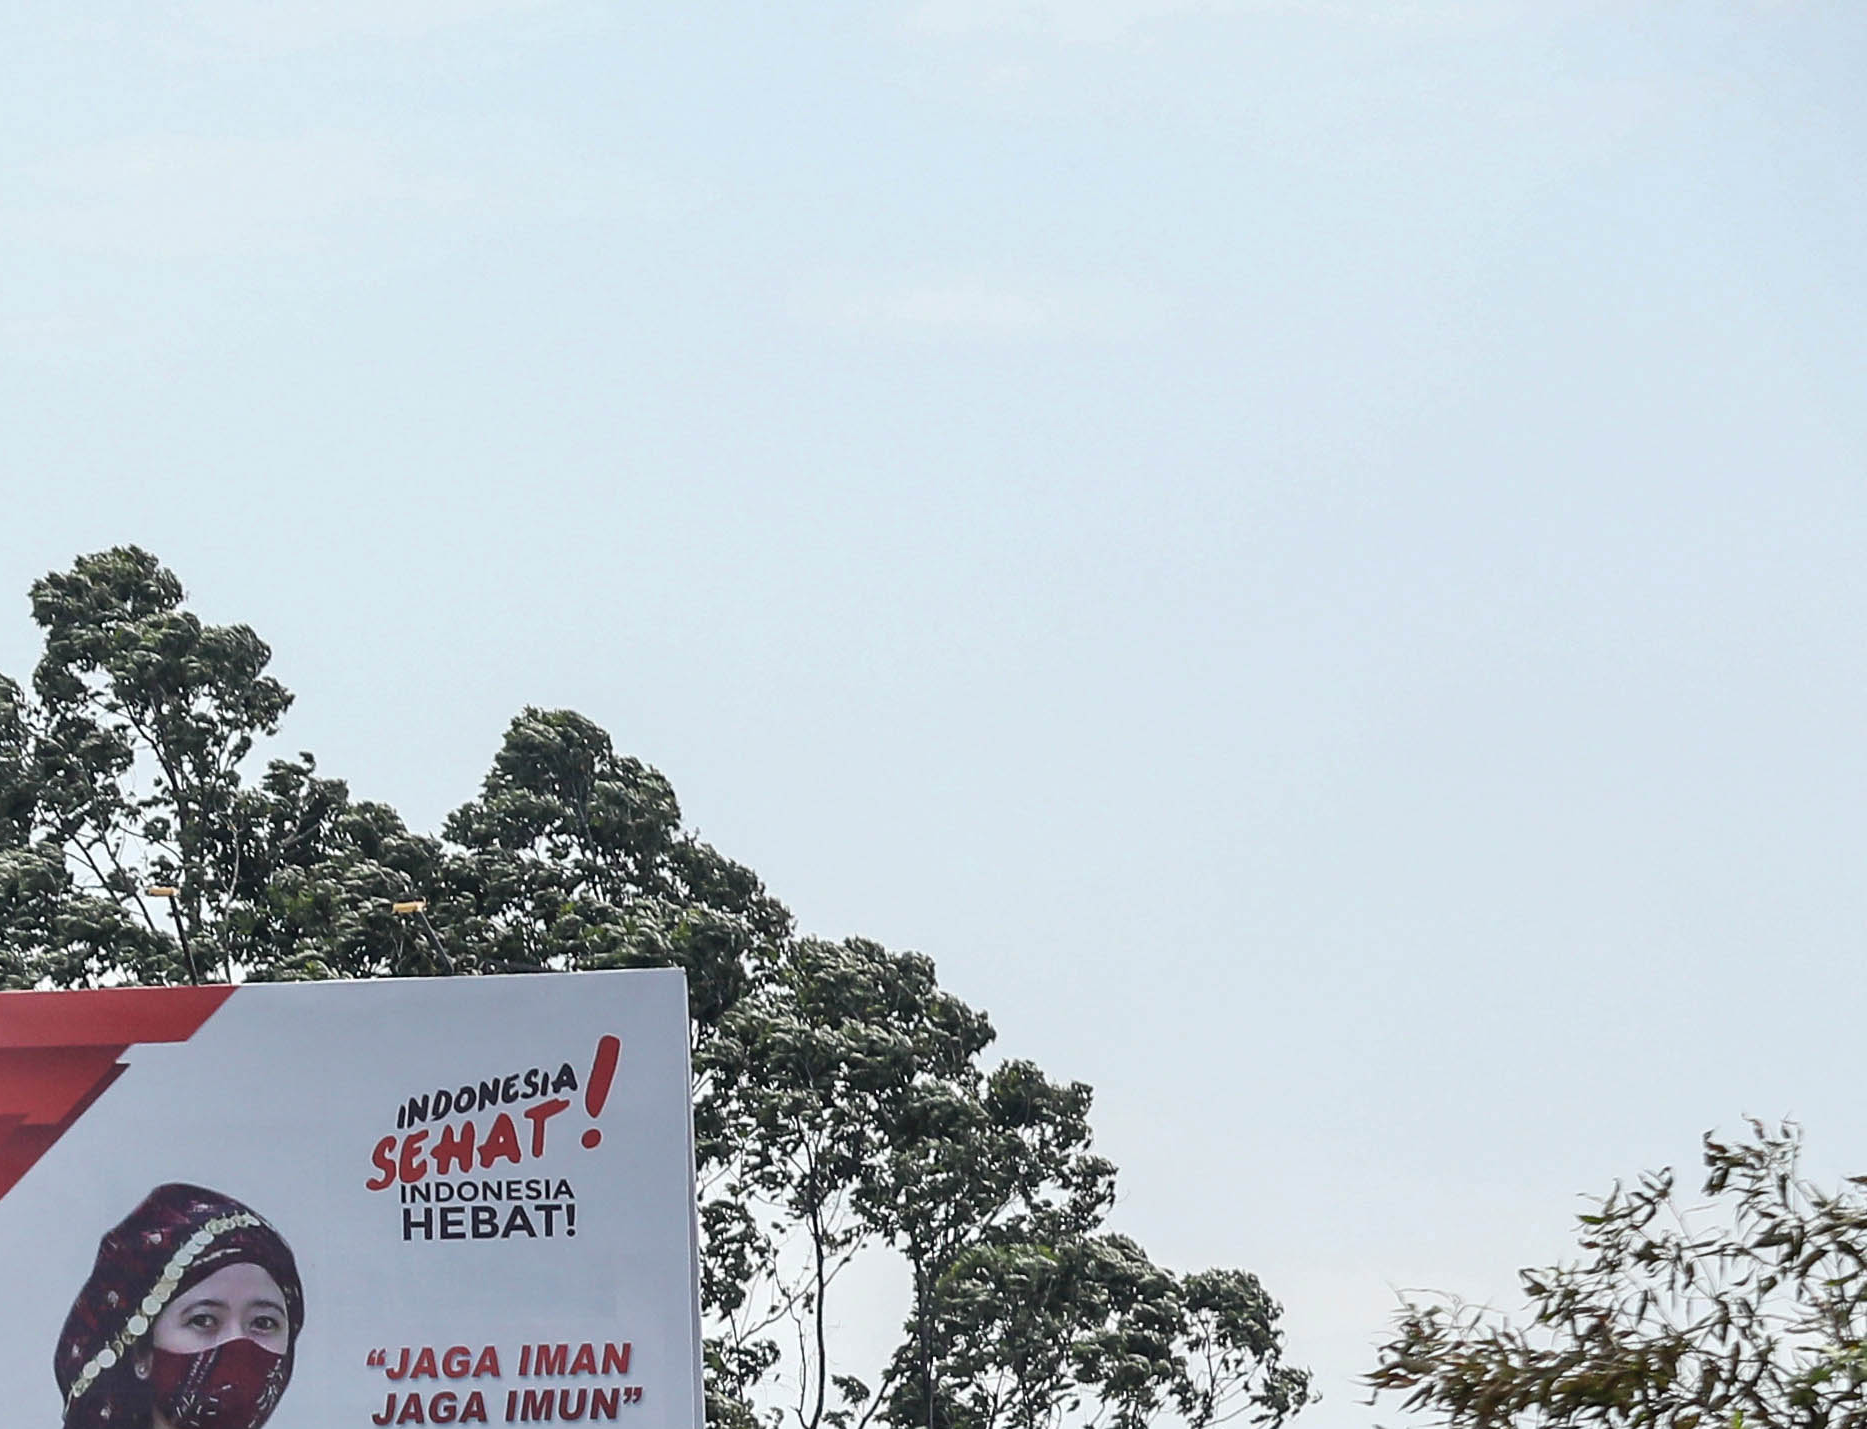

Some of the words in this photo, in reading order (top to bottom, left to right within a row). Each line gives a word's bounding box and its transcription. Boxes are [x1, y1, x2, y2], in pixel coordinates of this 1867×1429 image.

[365, 1034, 621, 1192] SEHAT!
[397, 1064, 578, 1129] INDONESIA
[400, 1180, 574, 1203] INDONESIA
[402, 1206, 577, 1241] HEBAT!
[517, 1344, 631, 1375] IMAN
[372, 1392, 488, 1426] JAGA
